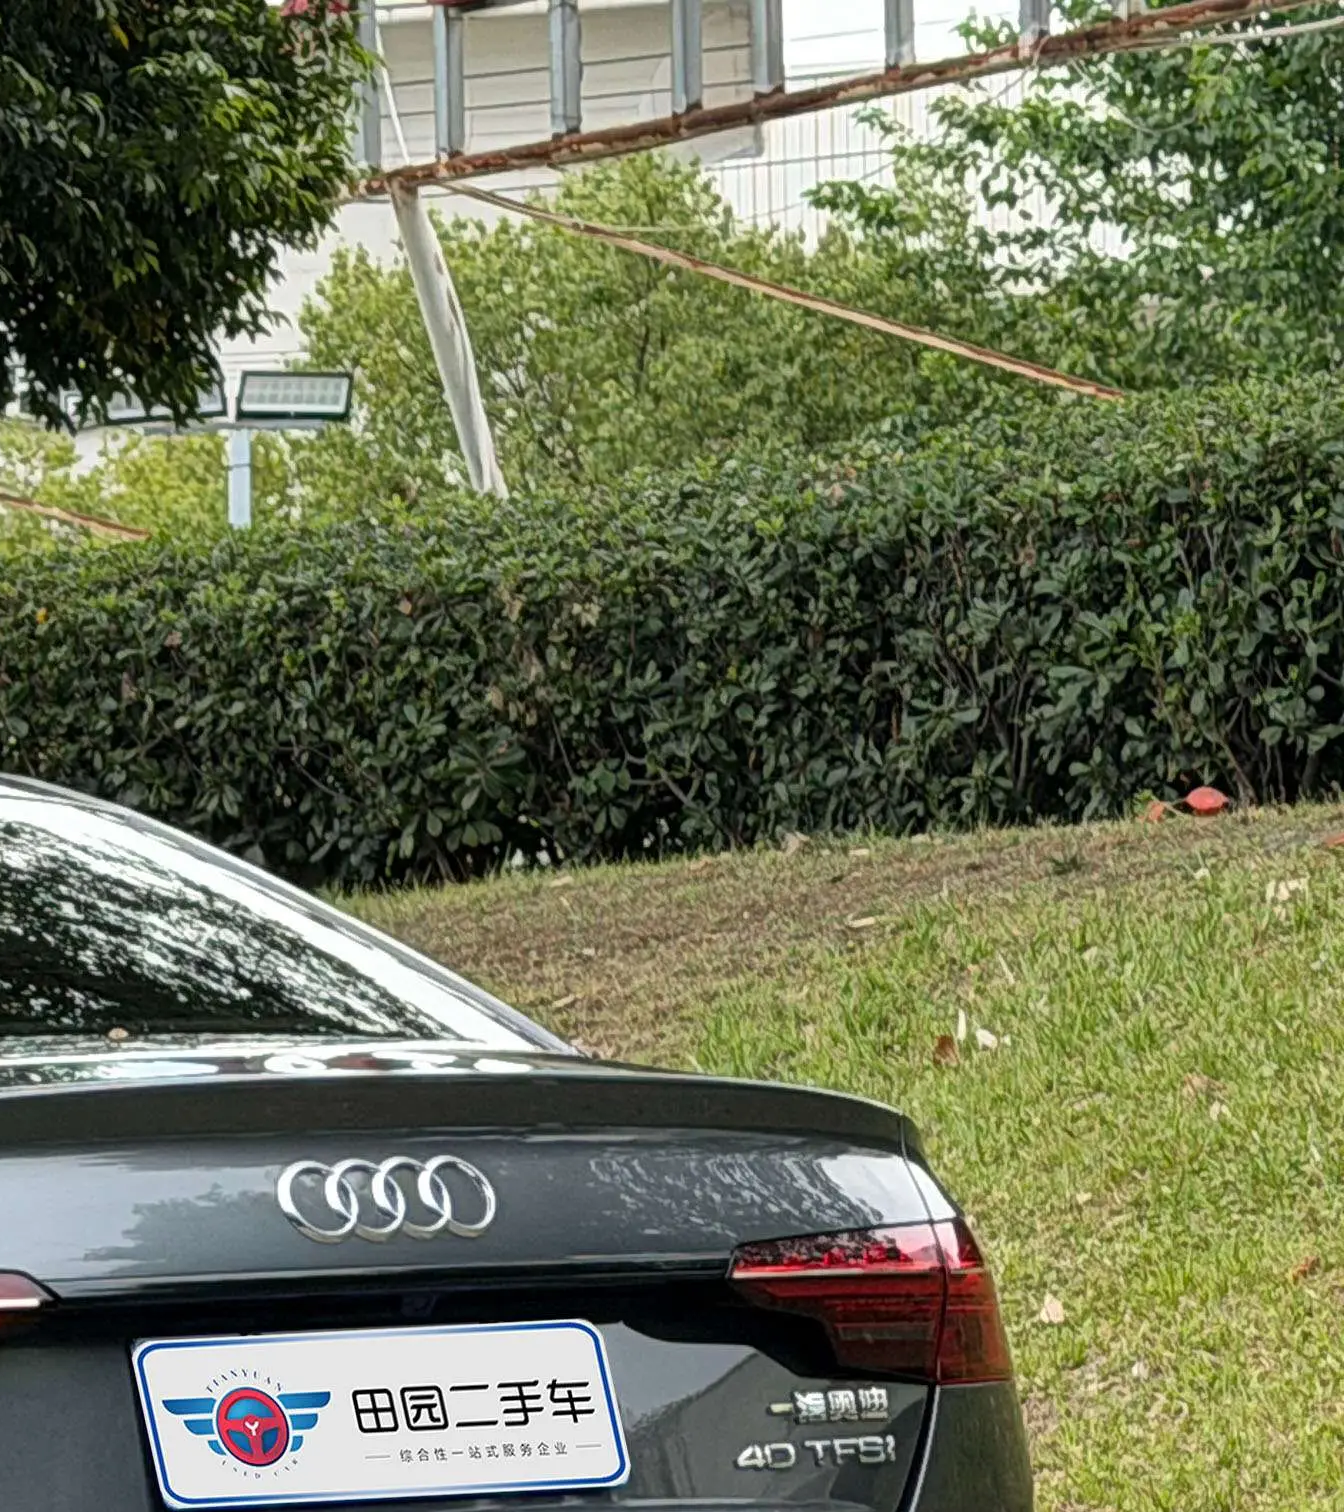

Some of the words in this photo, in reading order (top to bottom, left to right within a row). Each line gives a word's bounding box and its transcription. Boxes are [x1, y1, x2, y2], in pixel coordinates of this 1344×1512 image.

[351, 1379, 596, 1434] 田园二手车
[399, 1441, 569, 1463] 综合性一站式服务企业
[736, 1442, 796, 1469] 40
[804, 1435, 897, 1466] TFSI
